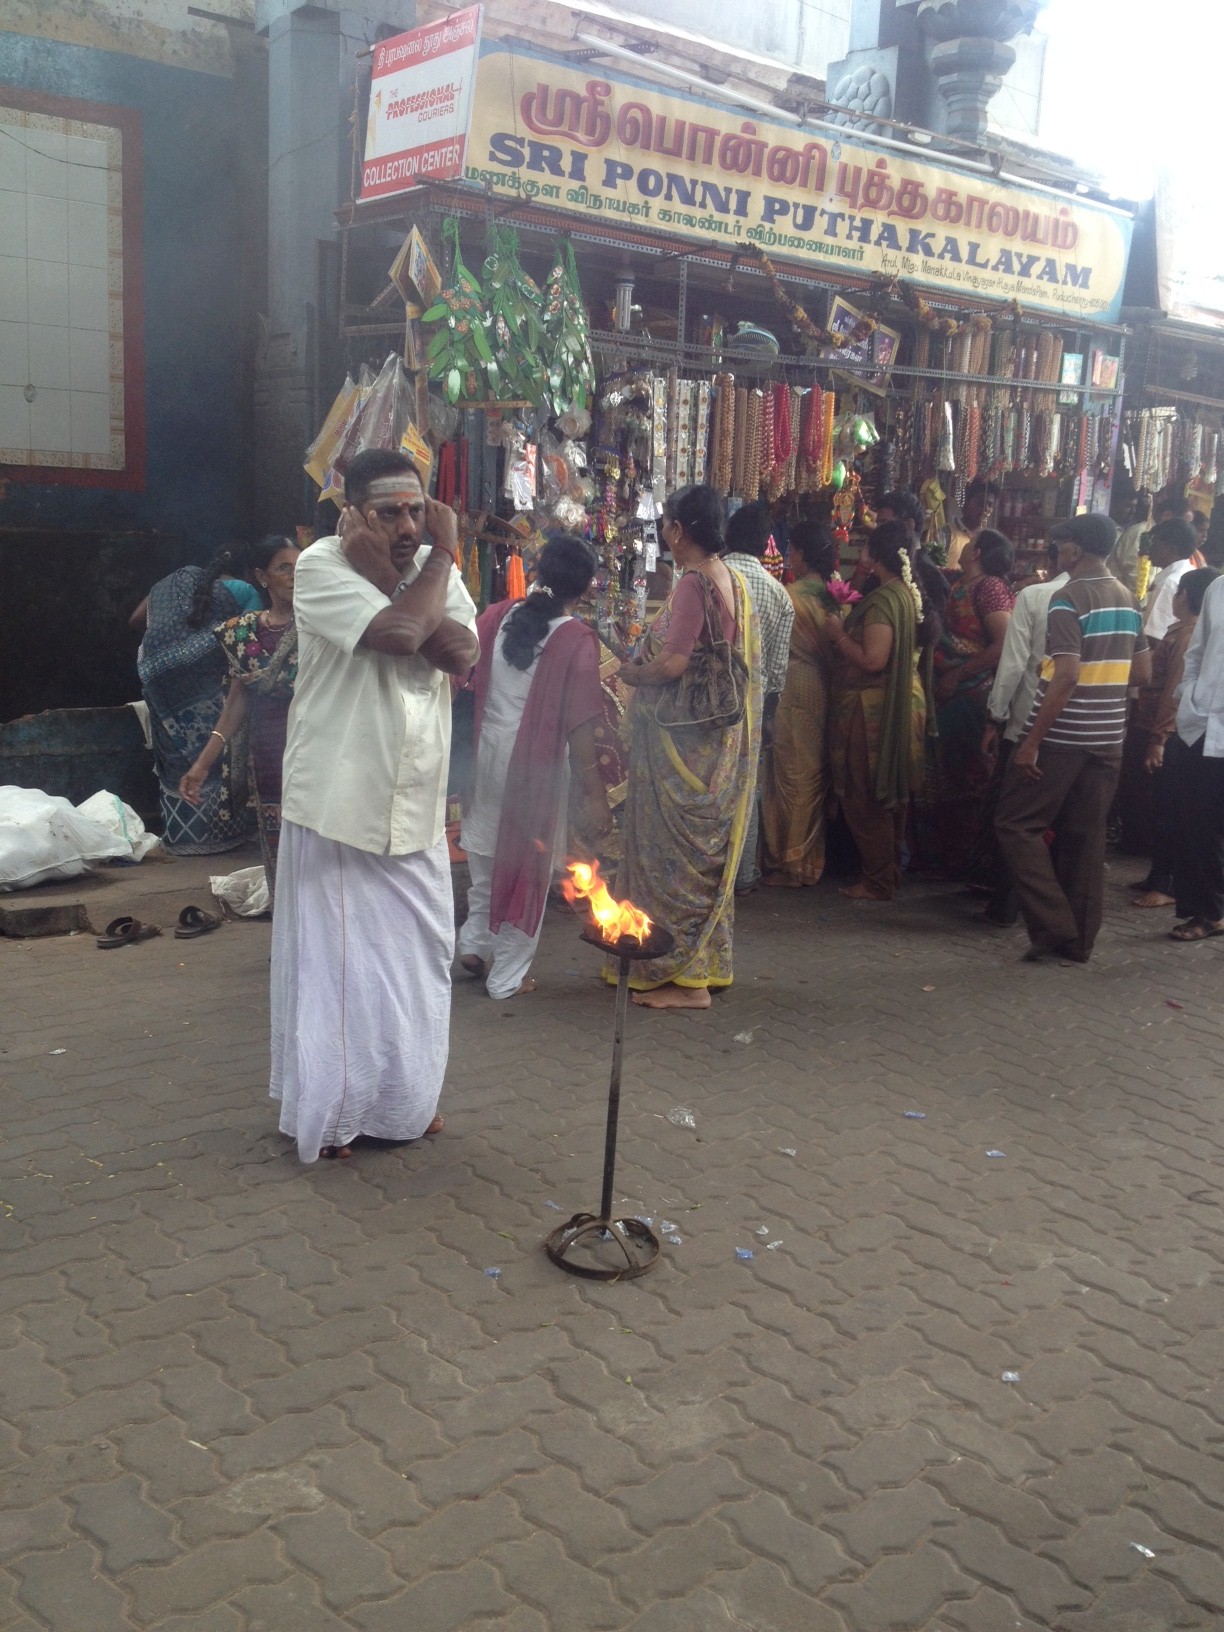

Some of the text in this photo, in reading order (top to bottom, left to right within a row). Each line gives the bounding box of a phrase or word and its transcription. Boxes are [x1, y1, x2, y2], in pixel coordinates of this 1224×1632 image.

[385, 82, 456, 120] PROFESSIONAL
[389, 88, 399, 99] THE
[417, 102, 455, 123] COURIERS
[363, 144, 460, 188] COLLECTION CENTER
[465, 165, 562, 199] மணக்குள
[566, 184, 652, 219] விநாயகர்
[657, 207, 742, 237] காலண்டர்
[488, 132, 1092, 290] SRI PONNI PUTHAKALAYAM
[834, 157, 1079, 252] புத்தகாலயம்
